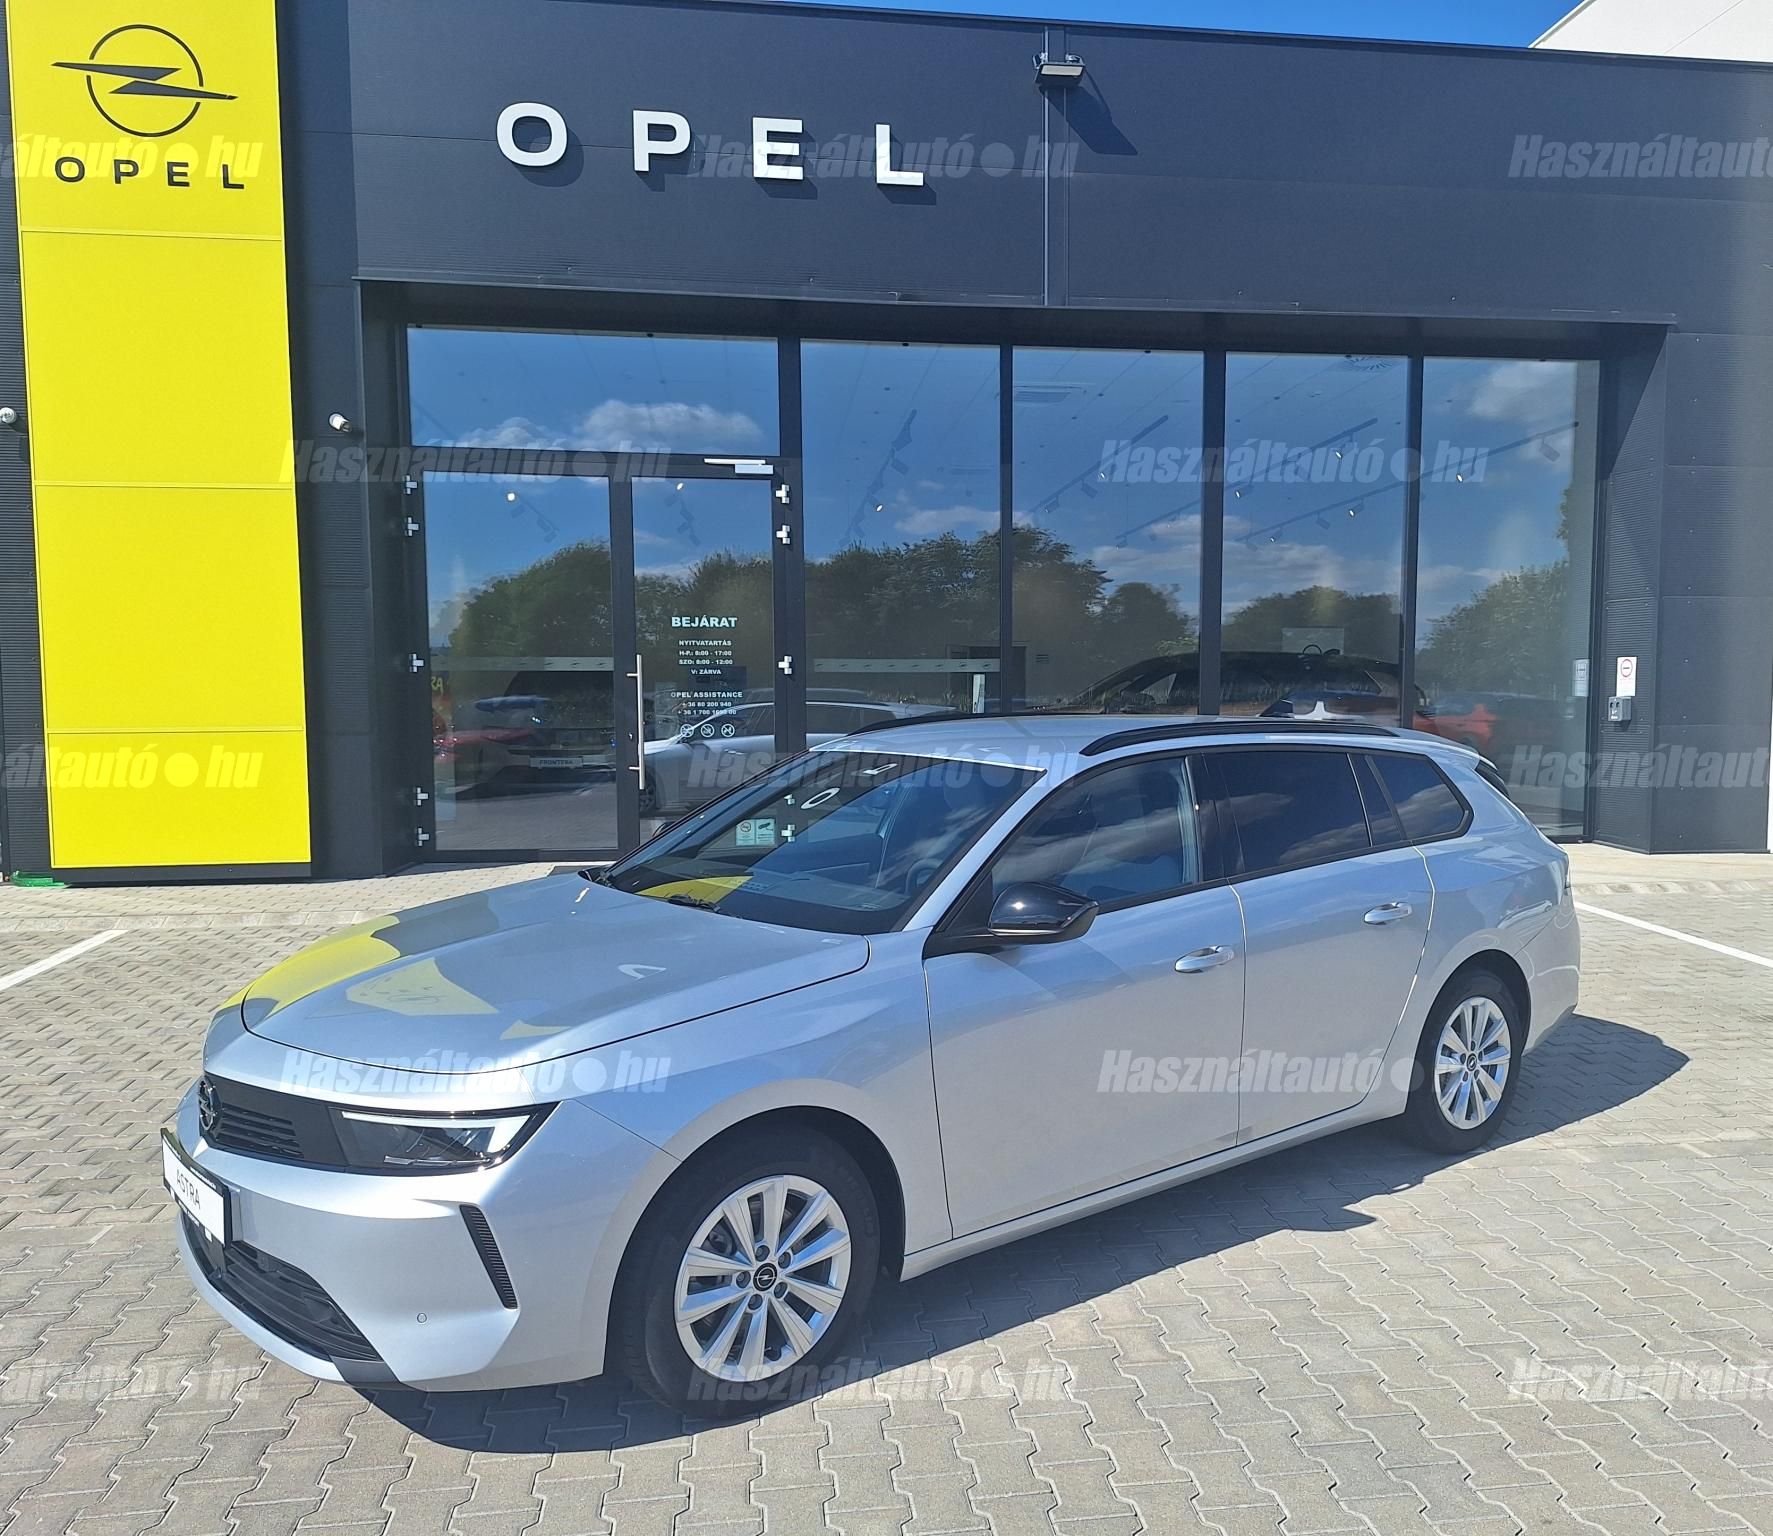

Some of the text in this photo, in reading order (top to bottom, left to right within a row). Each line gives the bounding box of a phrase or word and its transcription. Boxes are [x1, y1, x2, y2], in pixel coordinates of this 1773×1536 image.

[496, 101, 925, 187] OPEL
[54, 156, 245, 190] OPEL
[671, 614, 738, 628] BEJÁRAT
[175, 1168, 201, 1210] ASTRA
